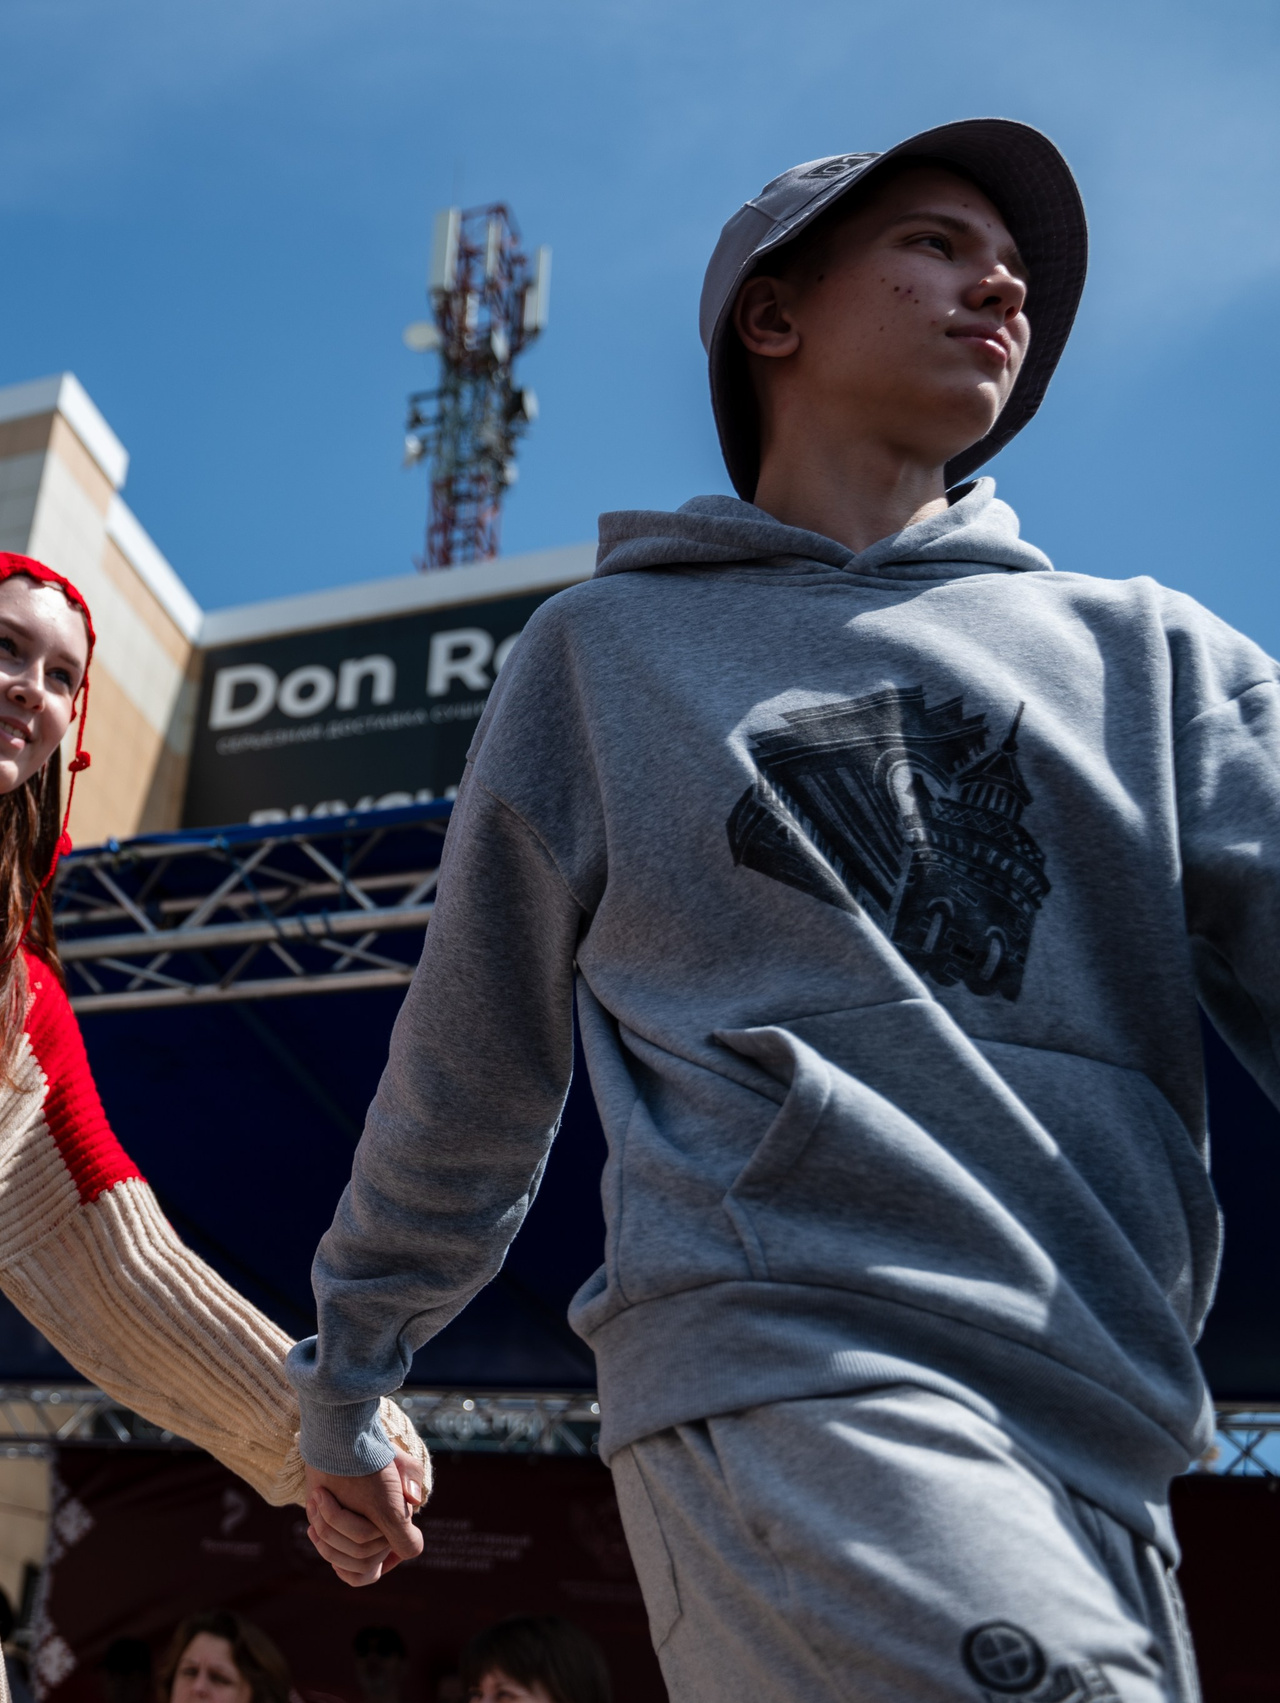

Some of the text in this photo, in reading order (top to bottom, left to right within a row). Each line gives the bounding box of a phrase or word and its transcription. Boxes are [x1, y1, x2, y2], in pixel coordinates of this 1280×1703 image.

[208, 653, 398, 732] Don
[324, 706, 428, 740] ДОСТАВКА
[429, 699, 486, 725] СУШ
